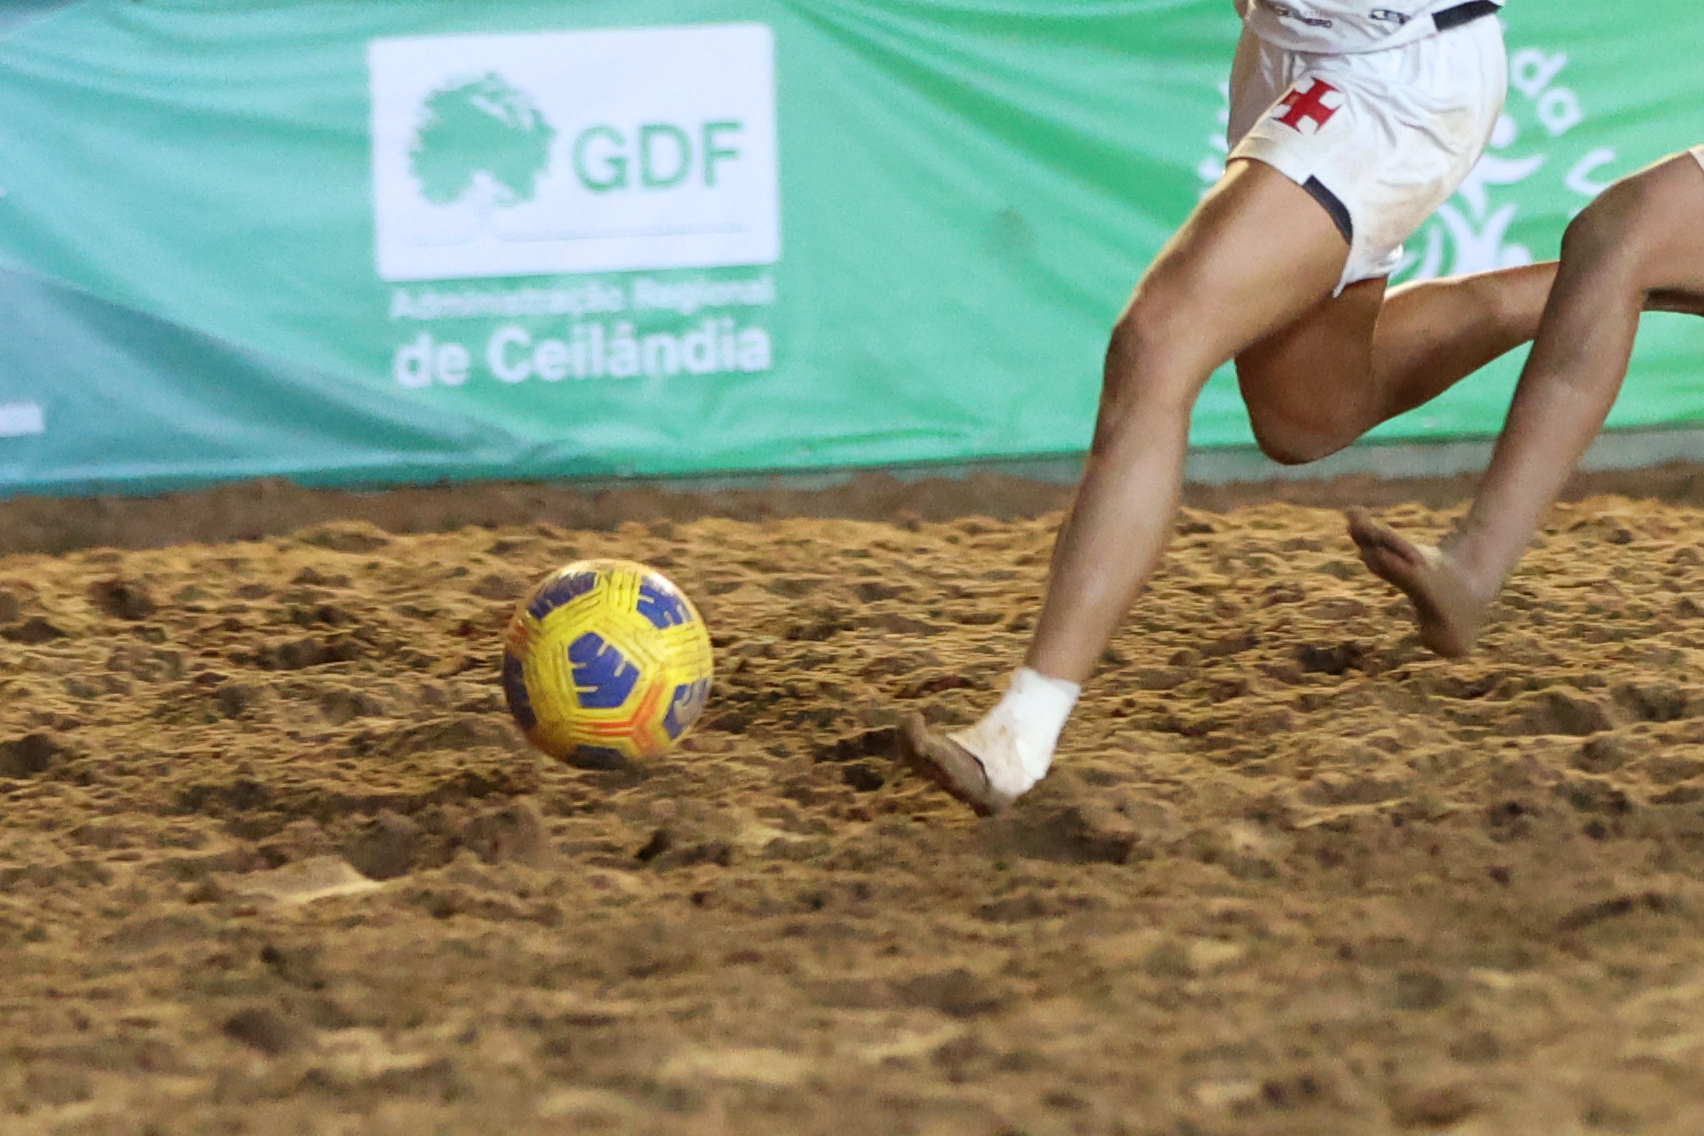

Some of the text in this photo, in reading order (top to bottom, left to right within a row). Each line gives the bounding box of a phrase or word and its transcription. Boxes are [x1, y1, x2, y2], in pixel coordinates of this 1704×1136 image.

[572, 120, 744, 194] GDF
[395, 318, 772, 388] de Ceilândia
